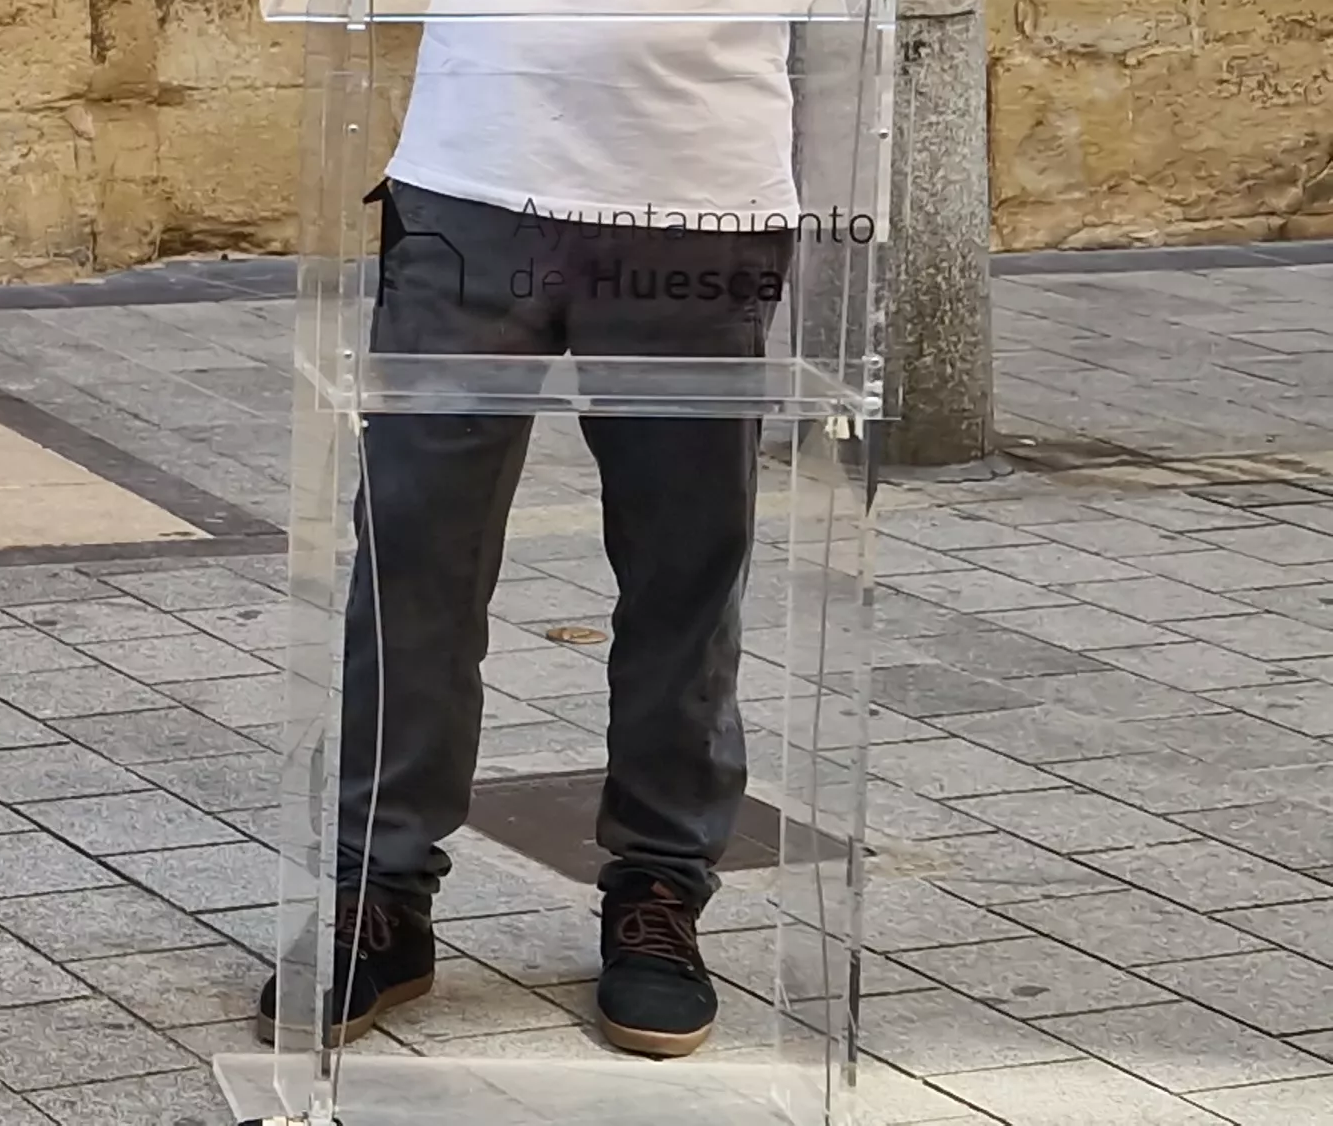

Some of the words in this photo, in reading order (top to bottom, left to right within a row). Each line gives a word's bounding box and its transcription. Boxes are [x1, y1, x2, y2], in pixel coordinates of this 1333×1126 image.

[512, 197, 876, 252] Ayuntamiento
[509, 257, 566, 300] de
[589, 257, 784, 302] Huesca
